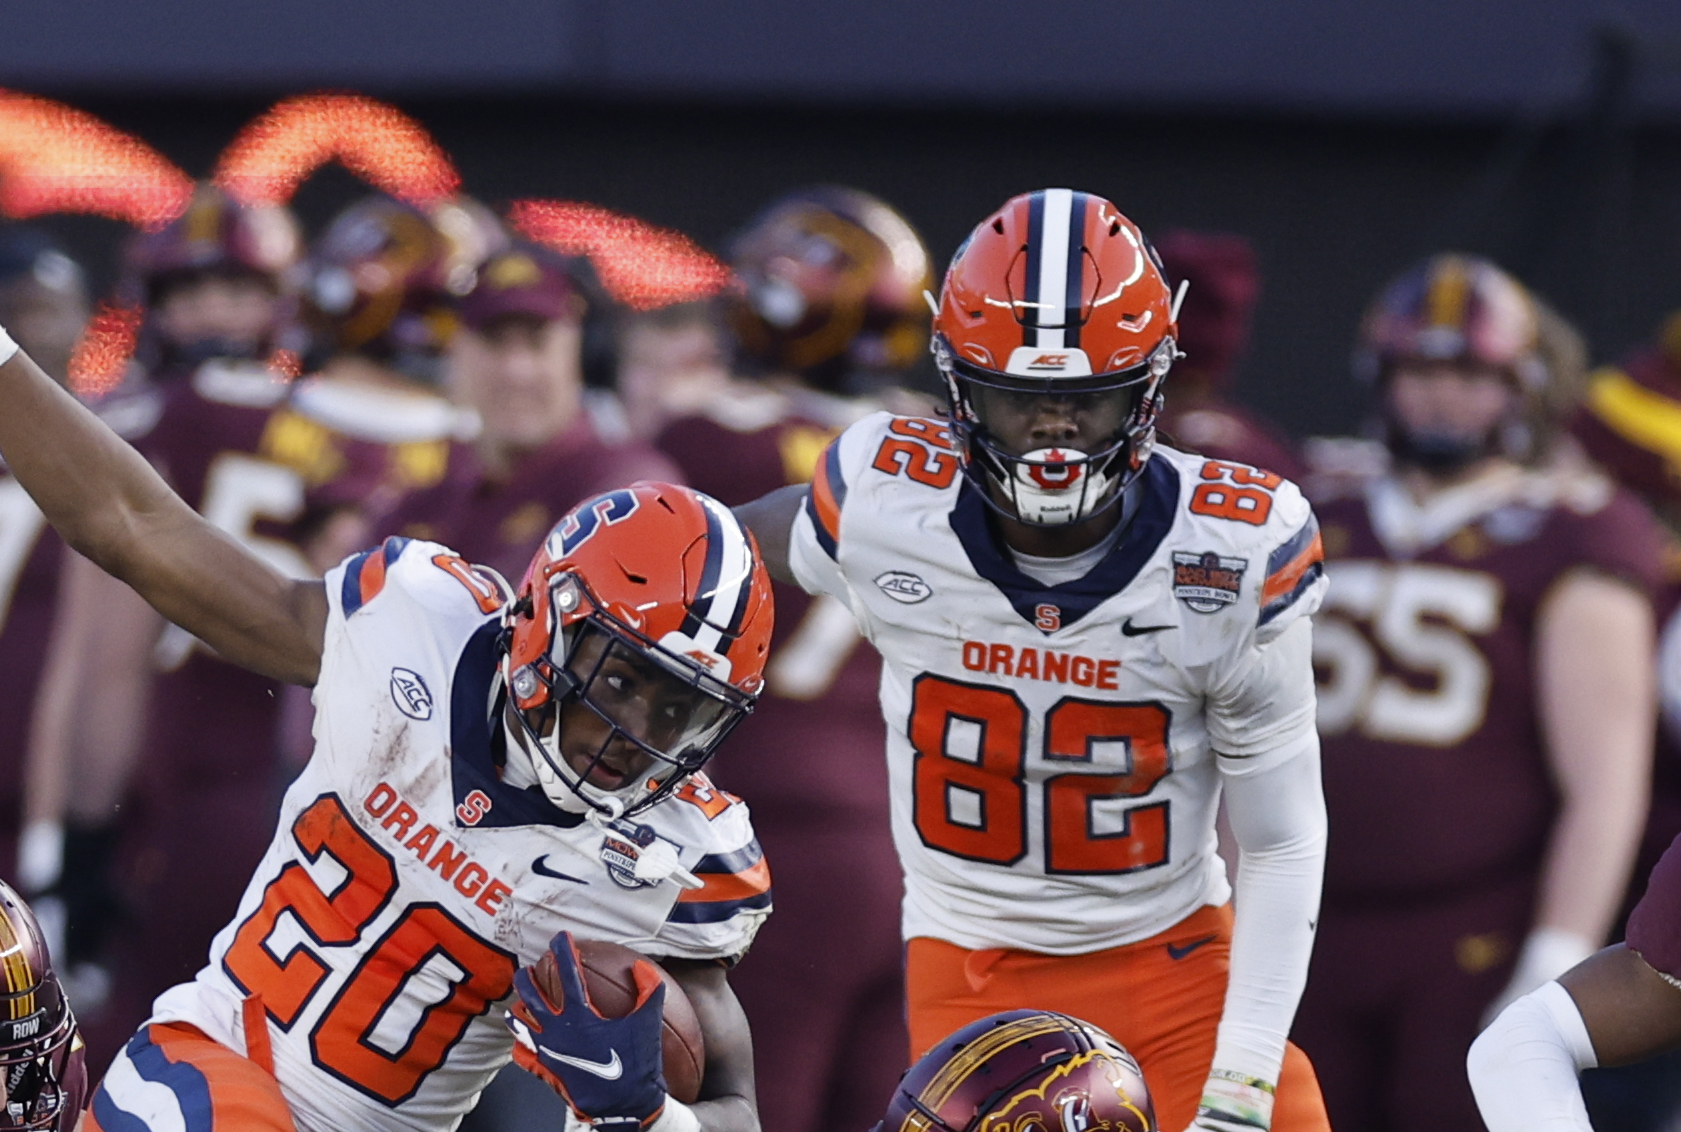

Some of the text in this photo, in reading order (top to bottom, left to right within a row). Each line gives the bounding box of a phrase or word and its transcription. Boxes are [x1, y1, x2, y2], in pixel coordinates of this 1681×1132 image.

[1031, 354, 1069, 366] ACC
[545, 489, 640, 562] S
[882, 577, 923, 595] ACC
[1034, 604, 1061, 632] S
[684, 649, 721, 669] ACC
[962, 639, 1122, 691] ORANGE
[396, 675, 433, 714] ACC
[906, 671, 1174, 875] 82
[455, 789, 492, 826] S
[363, 782, 513, 918] ORANGE
[222, 791, 520, 1108] 20
[12, 1017, 40, 1041] ROW
